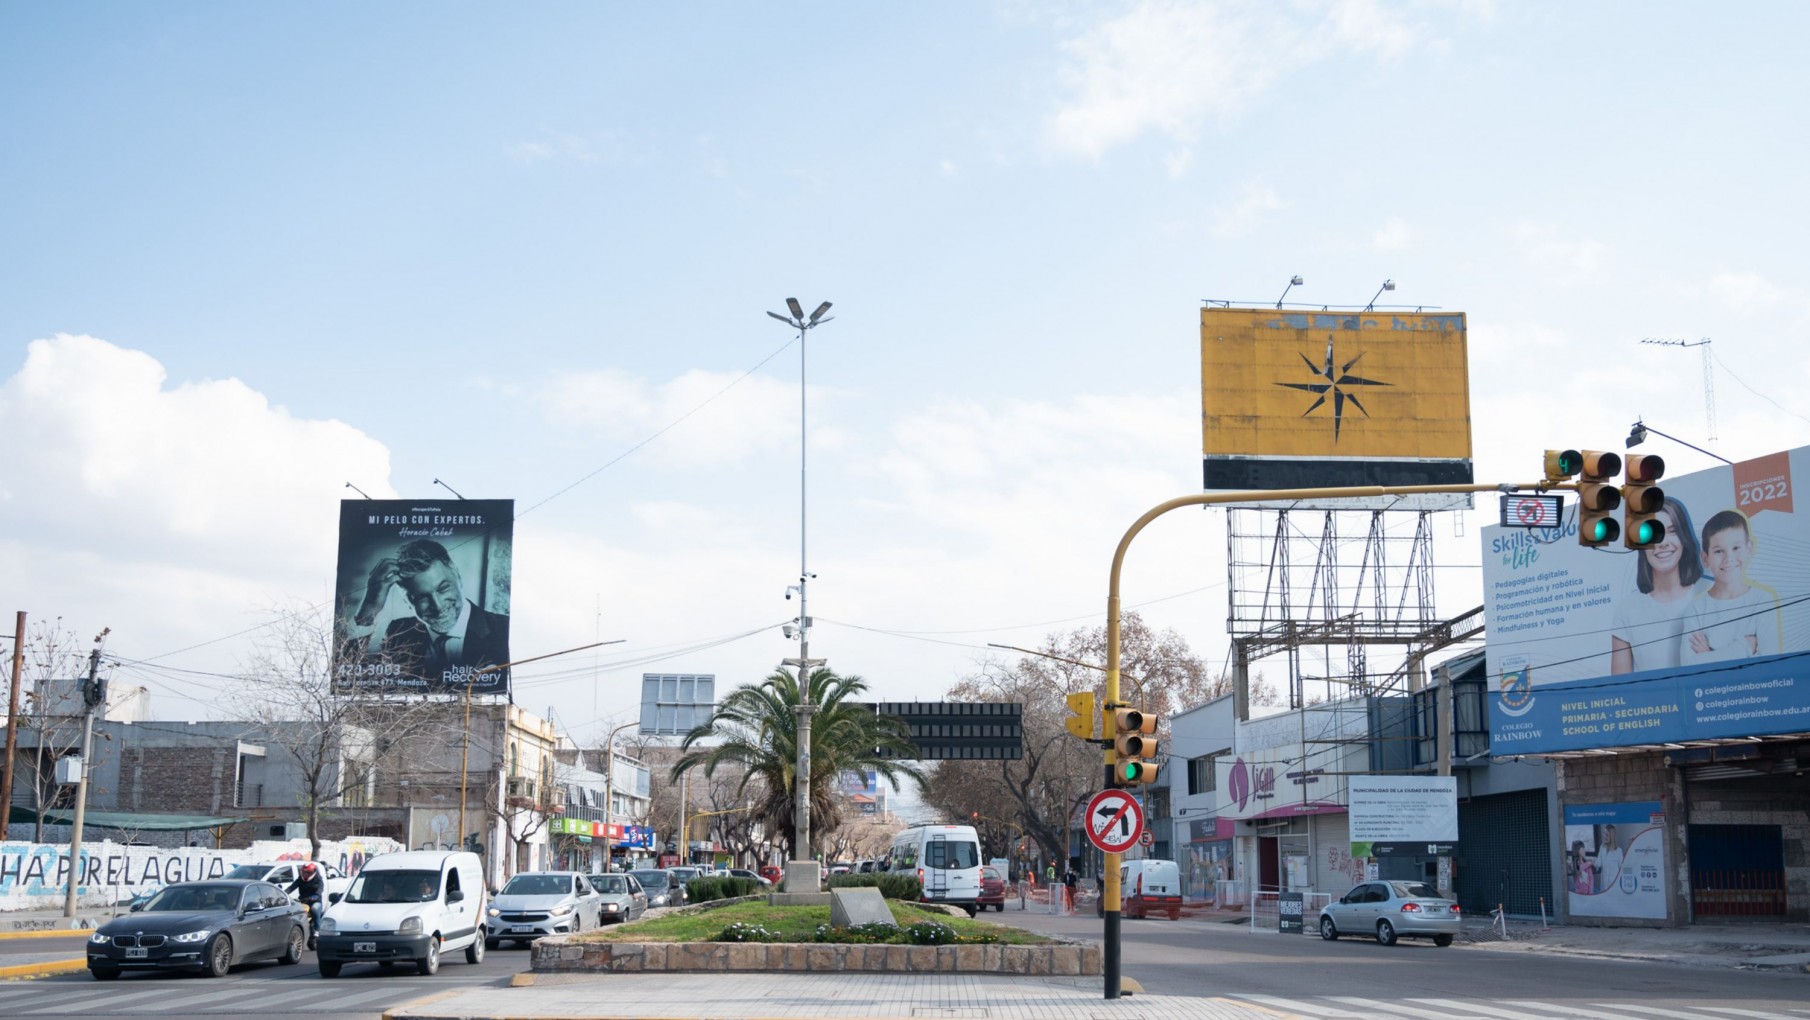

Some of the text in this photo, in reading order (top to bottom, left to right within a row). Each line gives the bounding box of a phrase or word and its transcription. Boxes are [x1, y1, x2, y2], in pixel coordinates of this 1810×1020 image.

[1740, 481, 1788, 506] 2022
[369, 515, 485, 525] MI PELO CON EXPERTOS.
[398, 527, 428, 537] Horacio
[1492, 531, 1533, 553] Skills
[1512, 543, 1540, 570] life
[1495, 569, 1568, 590] Pedagogías digitales
[1495, 578, 1583, 601] Programación y robótica
[1496, 595, 1553, 611] Psicomotricidad
[1565, 589, 1584, 599] Nivel
[1586, 584, 1610, 595] Inicial
[1497, 609, 1534, 622] Formación
[1535, 605, 1564, 616] humana
[1583, 597, 1611, 608] valores
[1497, 620, 1538, 633] Mindfulness
[1546, 616, 1565, 627] Yoga
[443, 671, 501, 684] Recovery
[452, 664, 473, 674] hair
[1704, 678, 1794, 695] colegiorainbowoficial
[1561, 697, 1626, 712] NIVEL INICIAL
[1705, 695, 1769, 709] colegiorainbow
[1562, 704, 1679, 724] PRIMARIA SECUNDARIA
[1696, 704, 1810, 723] www.colegiorainbow.edu.ar
[1502, 722, 1533, 731] COLEGIO
[1562, 718, 1660, 735] SCHOOL OF ENGLISH
[1494, 729, 1543, 742] RAINBOW
[56, 855, 102, 886] POR
[107, 856, 135, 886] EL
[140, 856, 225, 886] AGUA
[1280, 900, 1302, 908] MEJORES
[1280, 907, 1302, 915] VEREDAS
